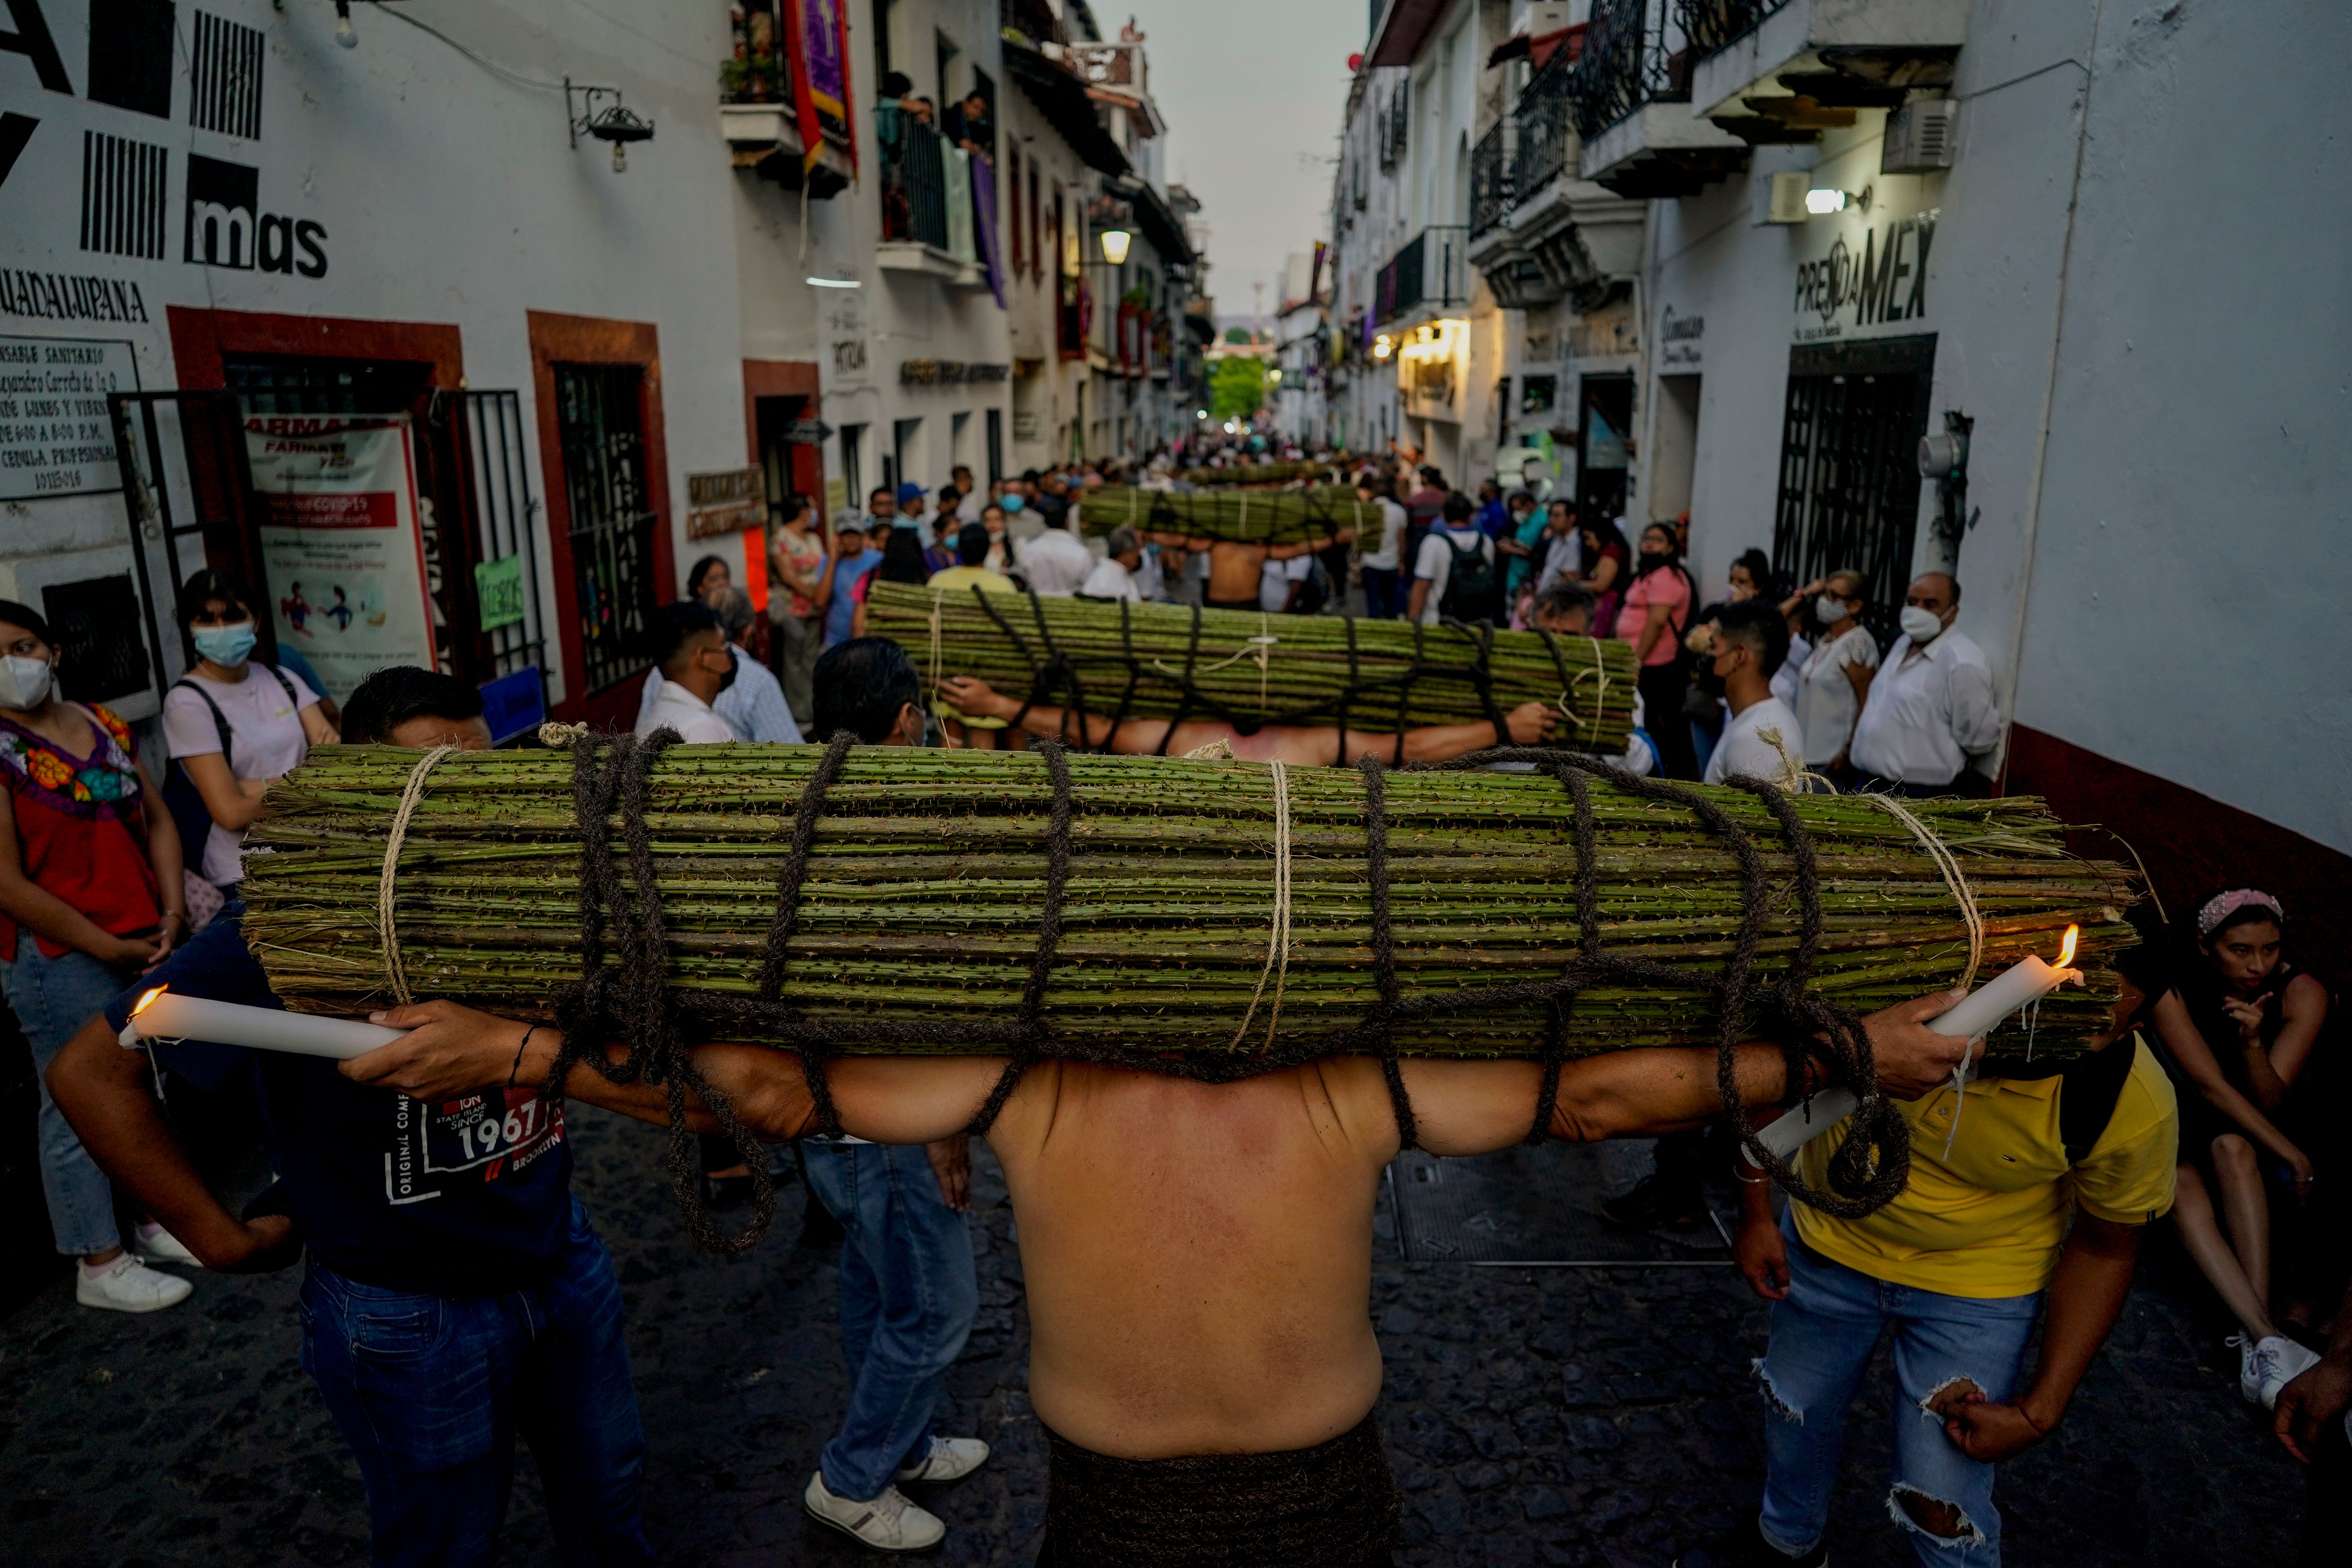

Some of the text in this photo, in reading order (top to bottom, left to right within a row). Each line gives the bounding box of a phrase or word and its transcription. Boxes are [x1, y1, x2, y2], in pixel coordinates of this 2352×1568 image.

[192, 199, 328, 278] mas
[1794, 207, 1941, 325] PRENDAMEX
[0, 268, 149, 323] UADALUPANA
[45, 346, 104, 365] SANITARIO
[25, 399, 60, 418] LUNES
[62, 399, 70, 418] Y
[40, 425, 49, 442] A
[436, 1102, 487, 1124] STATE ISLAND
[450, 1110, 485, 1131] SINCE
[458, 1098, 538, 1160] 1967
